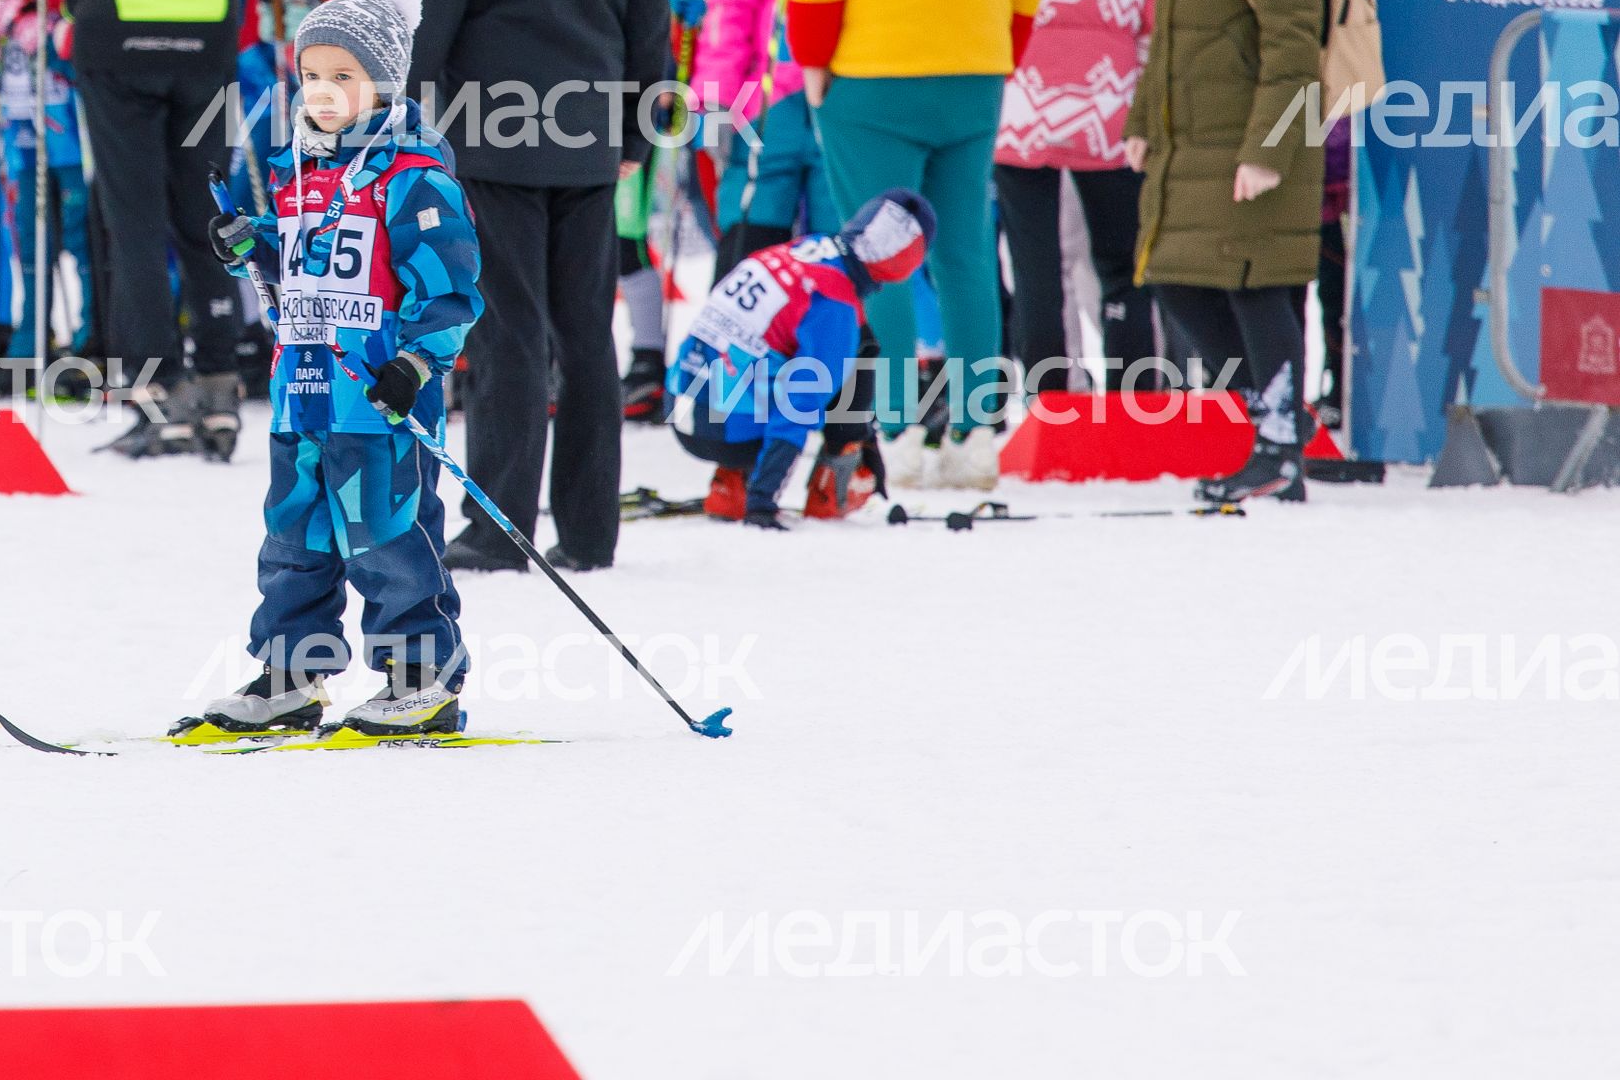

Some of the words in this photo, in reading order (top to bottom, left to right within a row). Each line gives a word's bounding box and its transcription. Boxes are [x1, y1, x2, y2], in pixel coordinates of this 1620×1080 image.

[326, 200, 345, 219] 54
[295, 368, 324, 380] ПАРК
[382, 690, 441, 716] FISCHER
